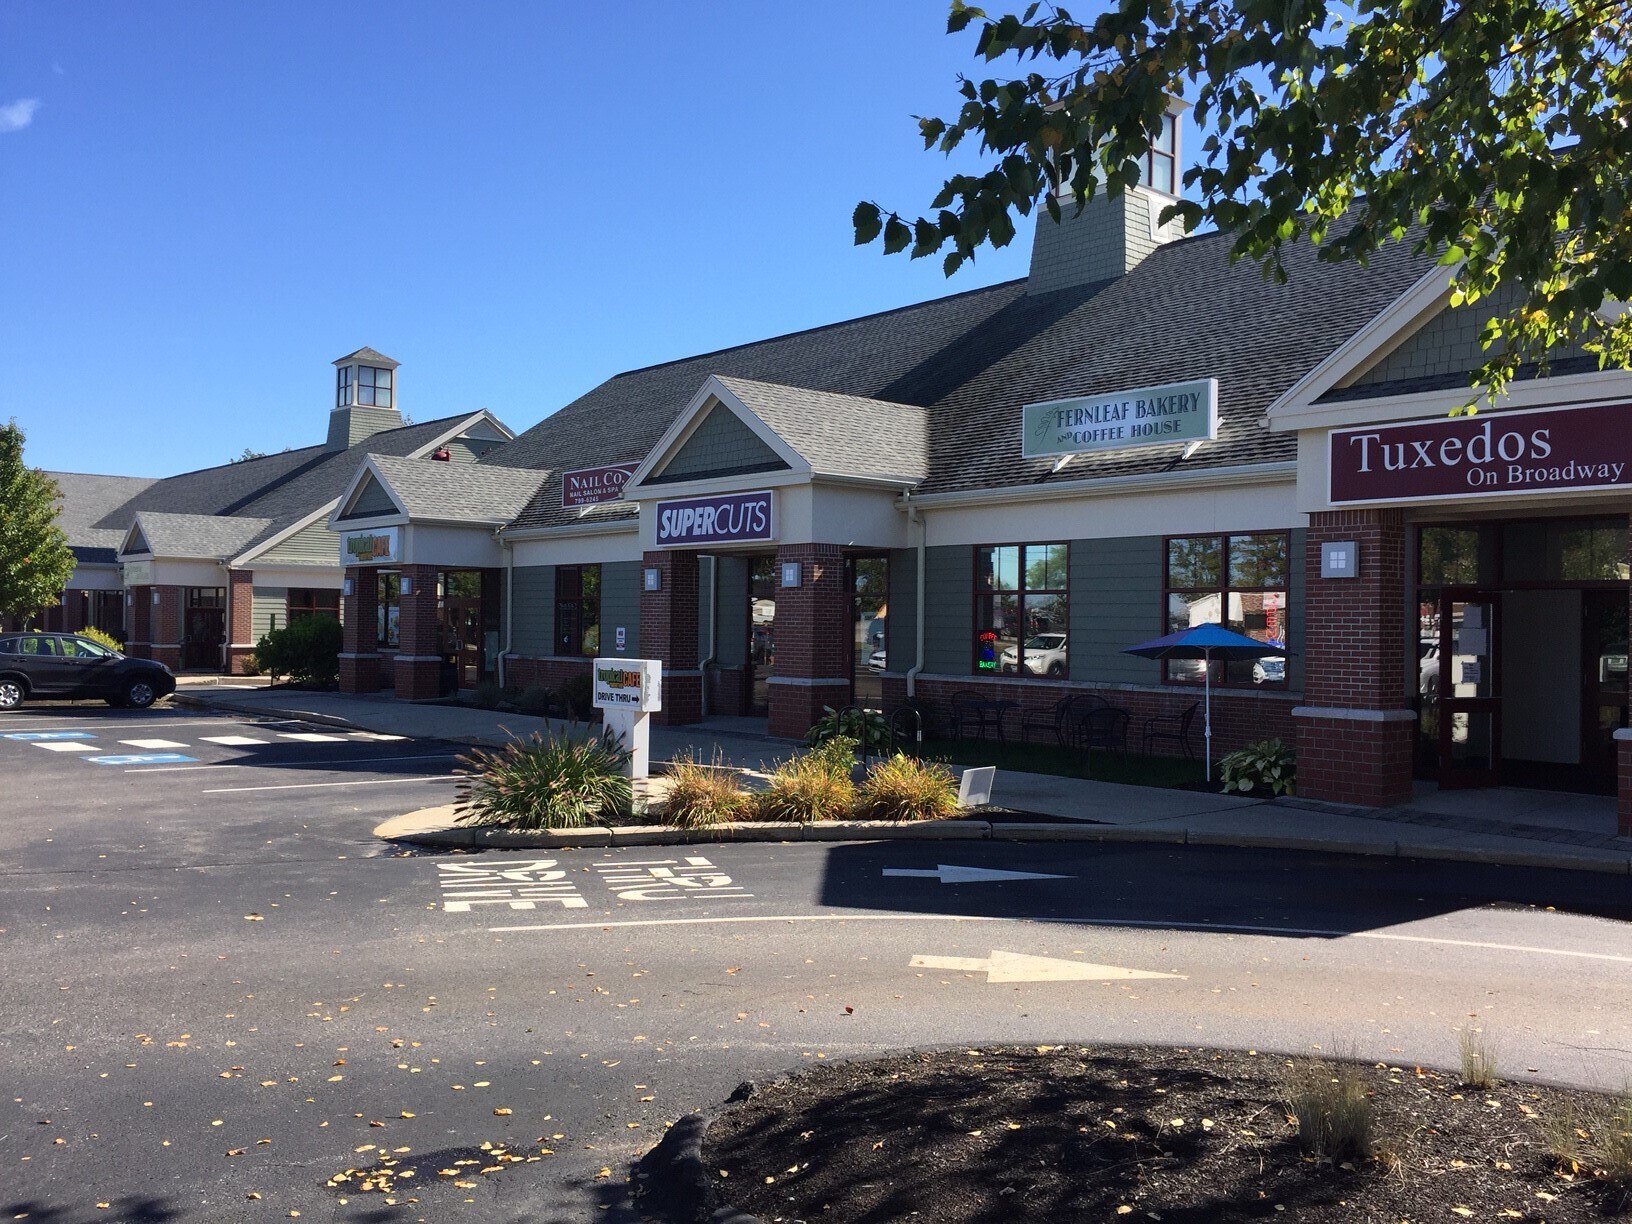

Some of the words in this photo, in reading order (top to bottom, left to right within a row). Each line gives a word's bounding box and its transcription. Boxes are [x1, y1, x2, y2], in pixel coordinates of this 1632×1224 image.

[1057, 402, 1129, 428] FERNLEAF
[1135, 392, 1201, 419] BAKERY
[1057, 431, 1072, 444] AND
[1073, 426, 1124, 444] COFFEE
[1130, 419, 1182, 438] HOUSE
[1350, 420, 1552, 473] Tuxedos
[1466, 467, 1498, 486] On
[1507, 460, 1626, 484] Broadway
[569, 490, 582, 498] NAIL
[583, 487, 602, 497] SALON
[659, 500, 767, 539] SUPERCUTS
[623, 671, 642, 688] CAFE
[597, 691, 615, 702] DRIVE
[615, 693, 631, 703] THRU
[436, 859, 589, 912] DRIVE
[592, 856, 754, 900] THRU
